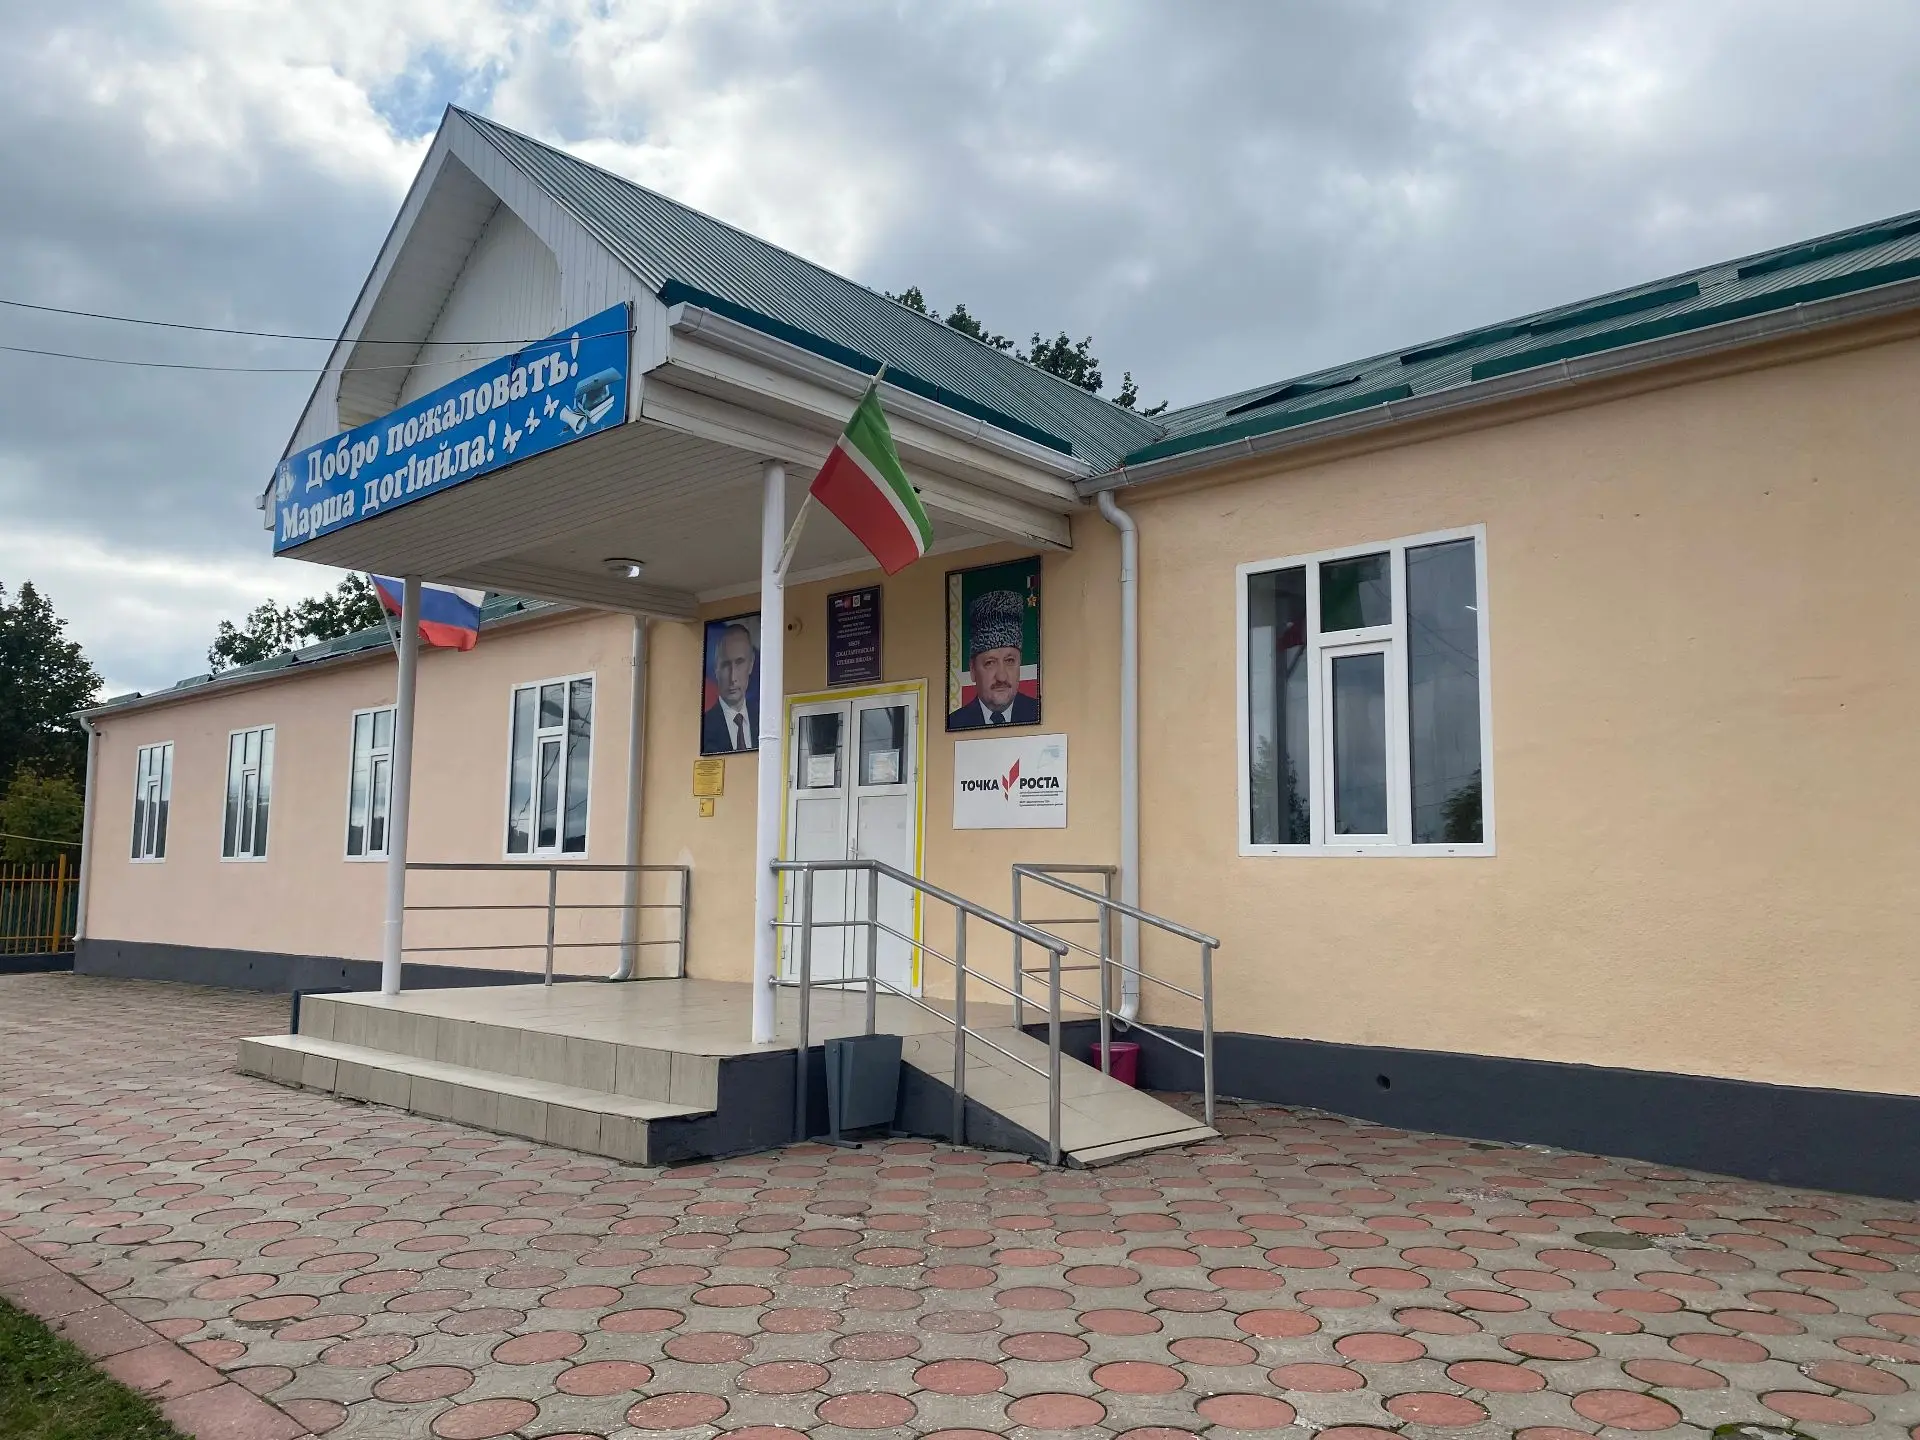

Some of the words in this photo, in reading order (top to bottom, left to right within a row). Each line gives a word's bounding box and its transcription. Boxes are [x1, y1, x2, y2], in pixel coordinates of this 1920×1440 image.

[306, 434, 379, 494] Добро
[386, 331, 580, 456] пожаловать!
[281, 477, 355, 543] Марша
[961, 779, 999, 791] ТОЧКА
[1019, 776, 1060, 789] РОСТА
